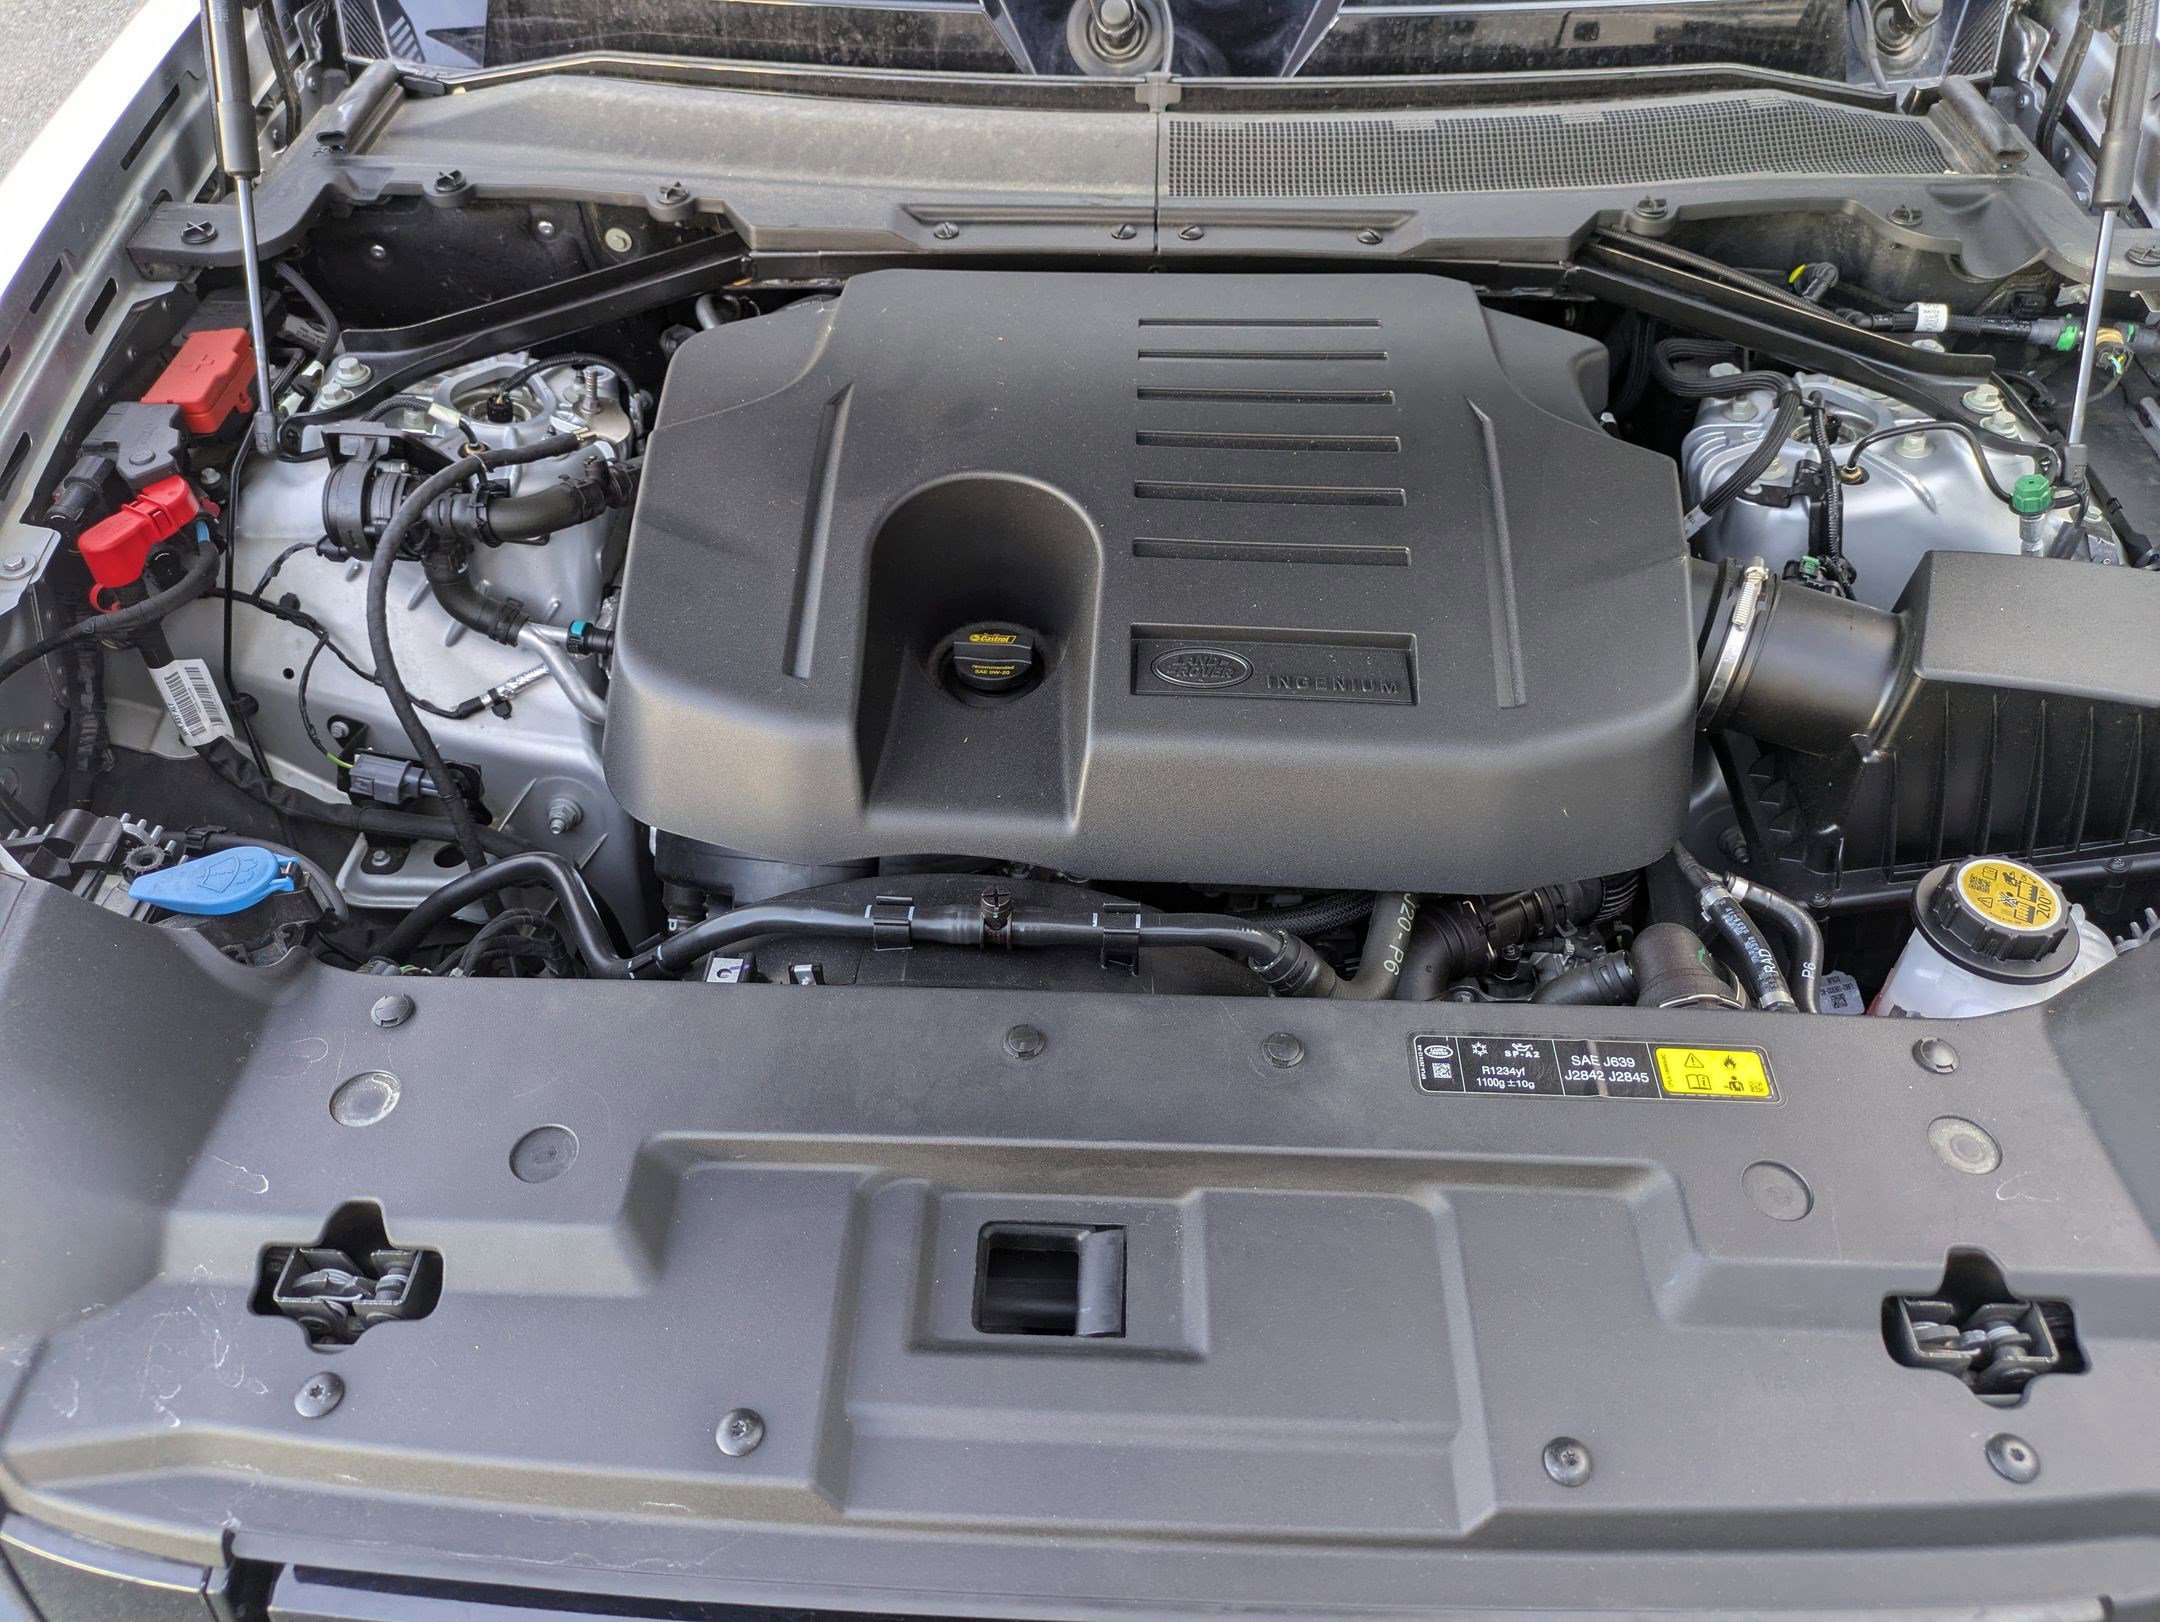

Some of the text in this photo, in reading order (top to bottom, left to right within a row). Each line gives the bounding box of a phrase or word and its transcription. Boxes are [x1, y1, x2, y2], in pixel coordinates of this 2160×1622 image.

[981, 635, 1009, 643] Castrol
[1172, 655, 1219, 666] LAND
[1265, 674, 1398, 695] INGENIUM
[2036, 896, 2052, 919] 200
[1758, 949, 1777, 974] RAD
[1802, 961, 1817, 979] P6
[1504, 1050, 1541, 1058] SP-A2
[1570, 1055, 1636, 1068] SAE J639
[1481, 1065, 1526, 1077] R1234yf
[1564, 1069, 1650, 1083] J2842 J2845
[1476, 1077, 1505, 1089] 1100g
